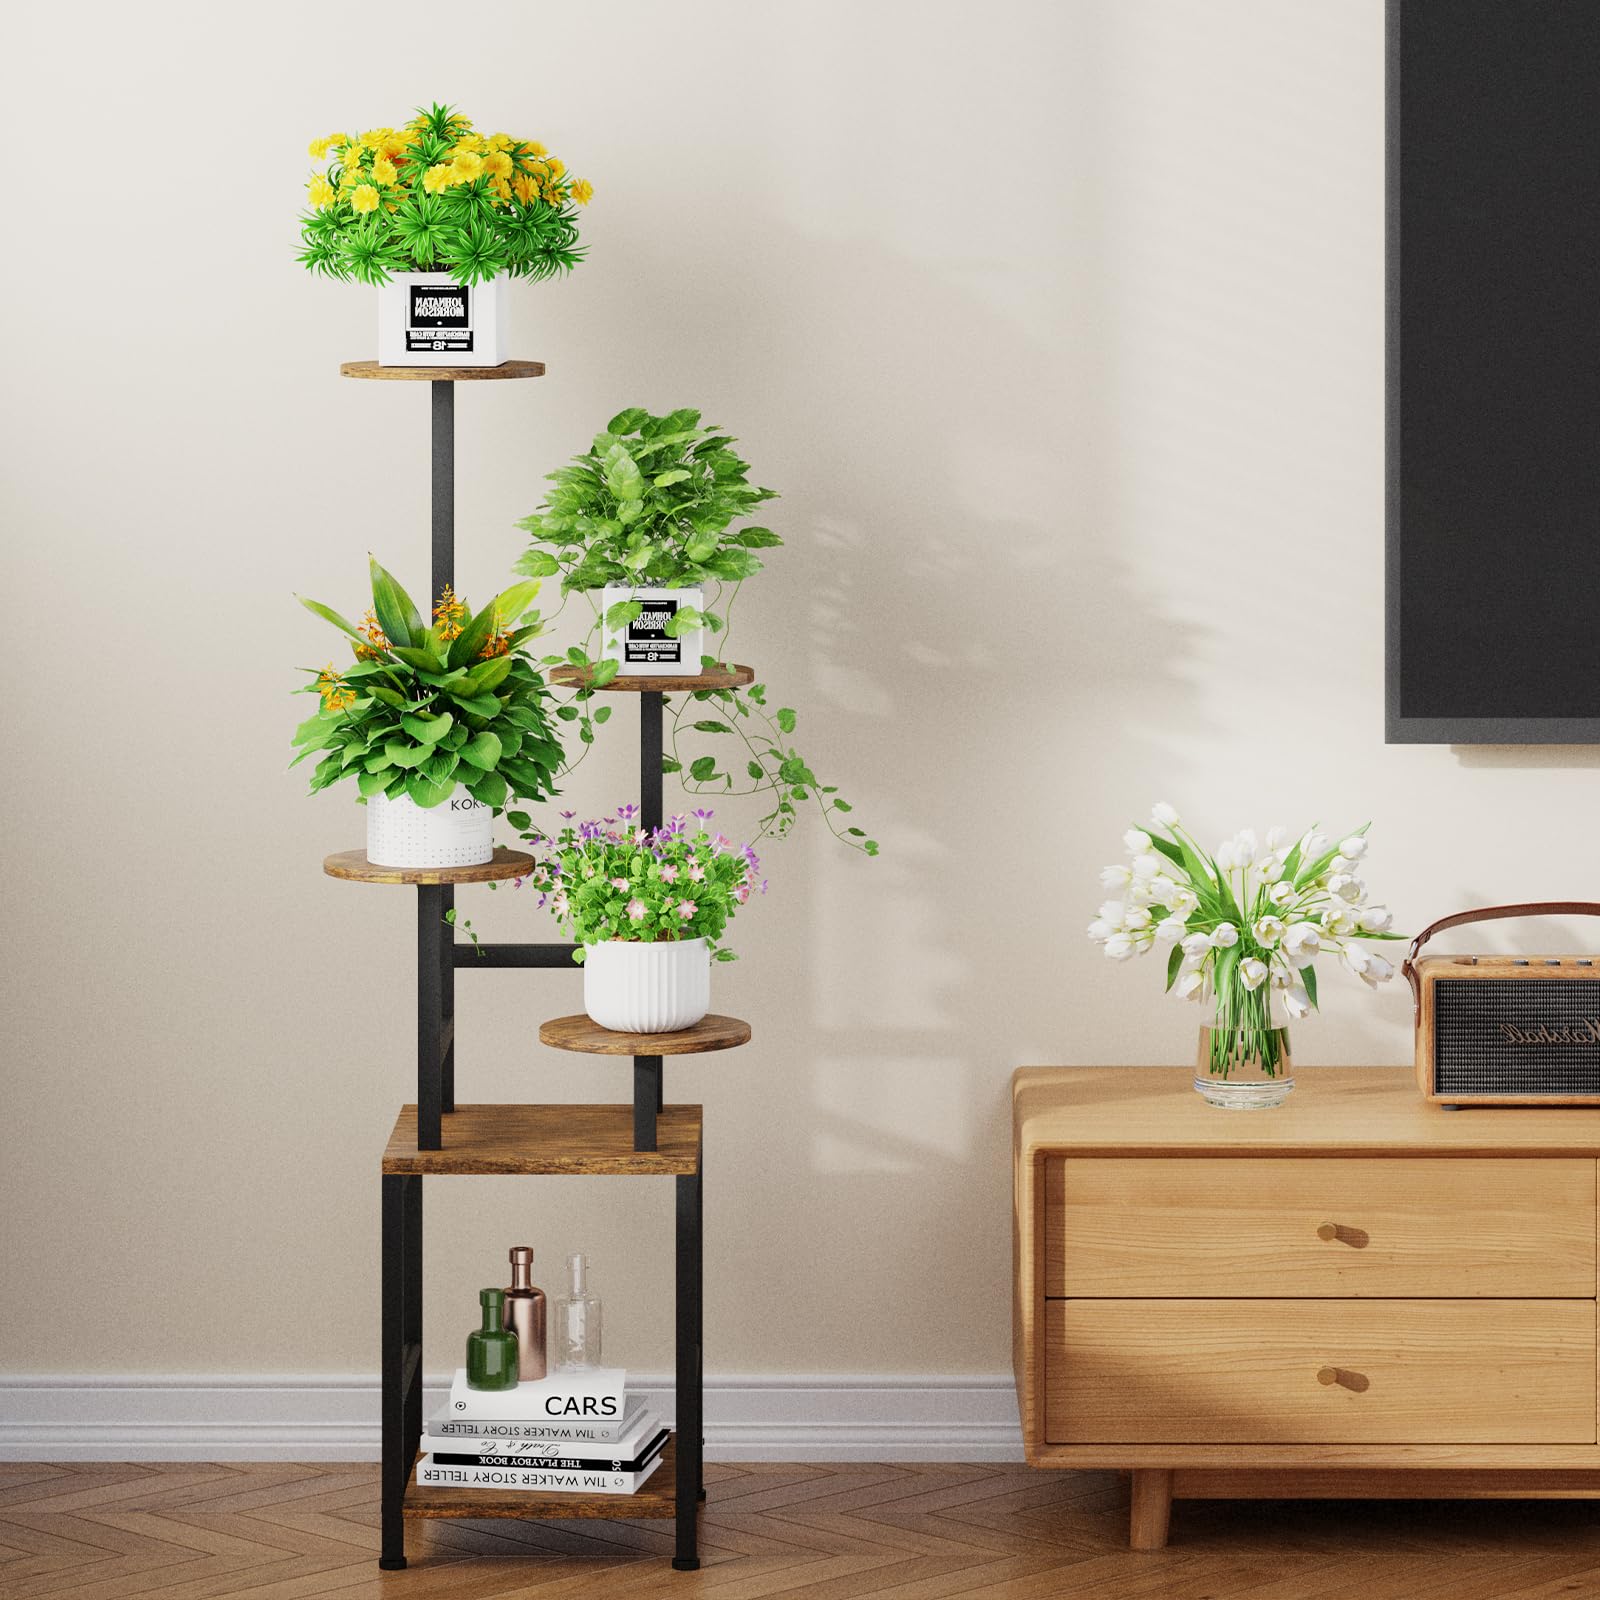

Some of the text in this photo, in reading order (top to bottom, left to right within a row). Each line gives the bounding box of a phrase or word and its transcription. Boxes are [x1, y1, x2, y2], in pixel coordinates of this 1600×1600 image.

[545, 1396, 617, 1416] CARS
[442, 1424, 595, 1438] TIM WALKER STORY TELLER
[479, 1456, 581, 1468] THE PLAYBOY BOOK
[424, 1470, 607, 1487] TIM WALKER STORY TELLER
